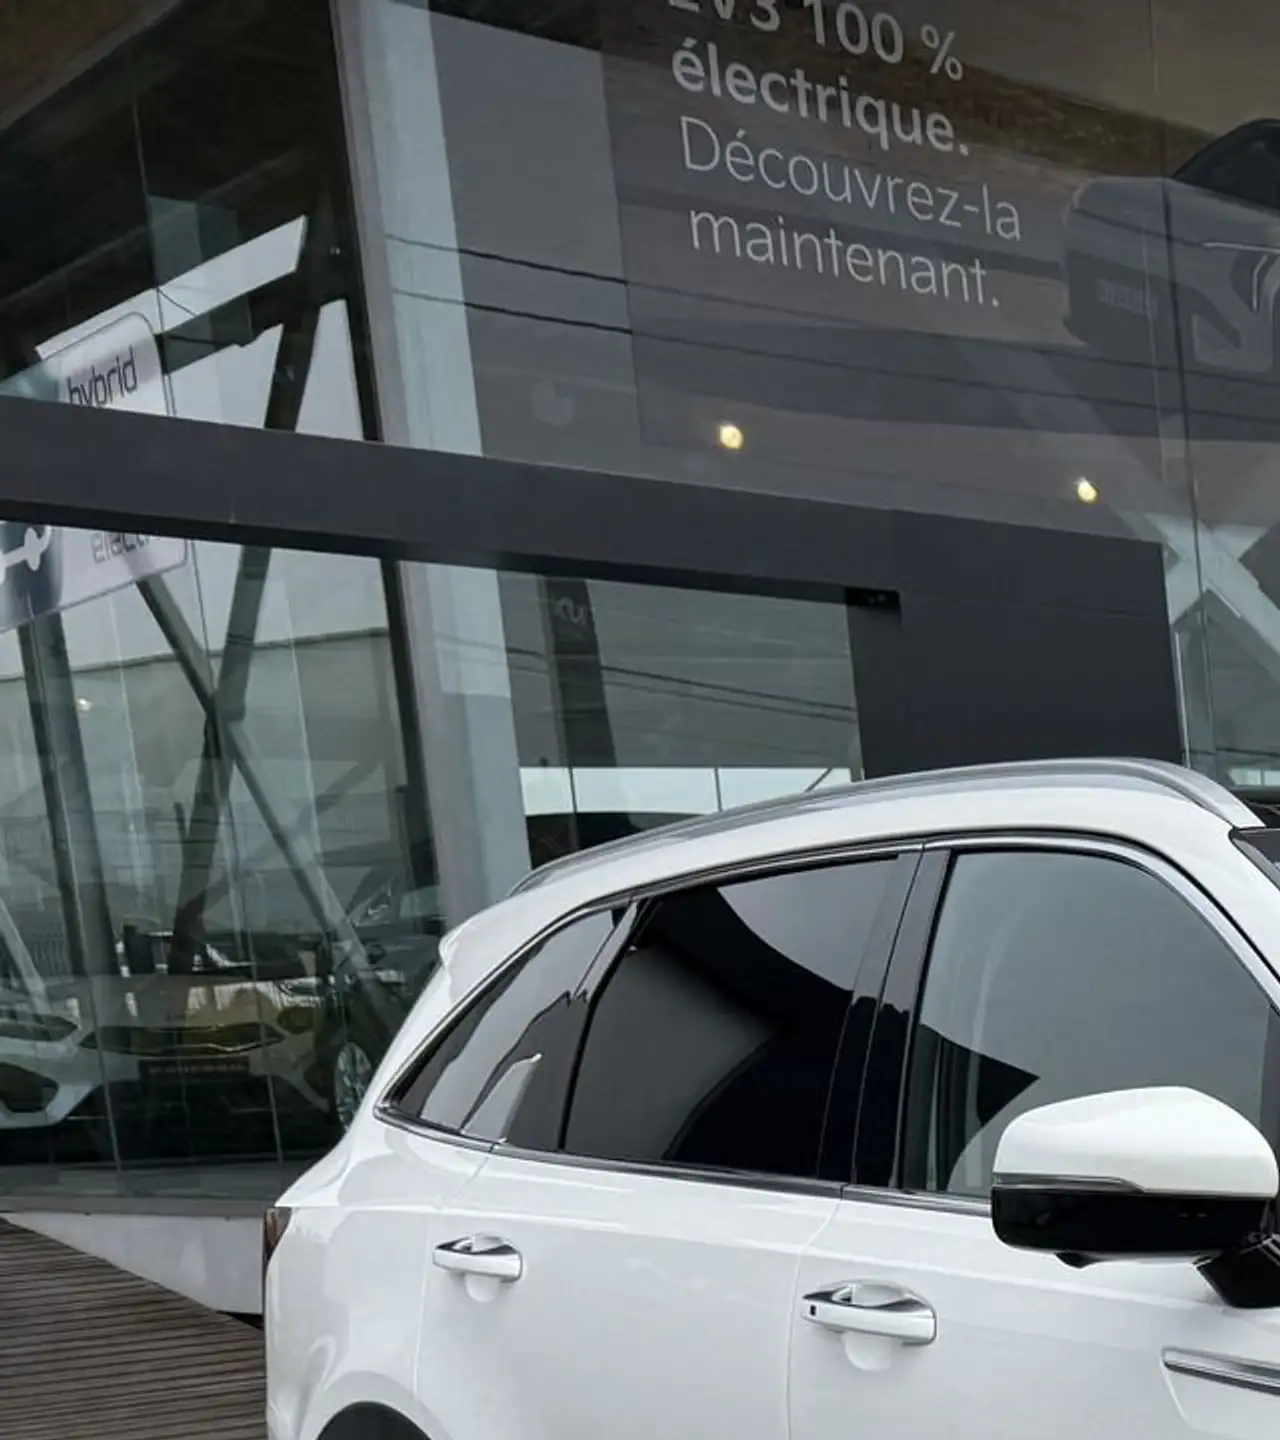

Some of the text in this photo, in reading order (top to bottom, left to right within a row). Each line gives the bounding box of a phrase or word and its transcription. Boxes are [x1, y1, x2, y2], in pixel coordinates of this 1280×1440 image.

[803, 0, 904, 64] 100
[920, 23, 964, 82] %
[671, 37, 969, 157] électrique.
[680, 115, 1021, 242] Découvrez-la
[690, 208, 1000, 308] maintenant.
